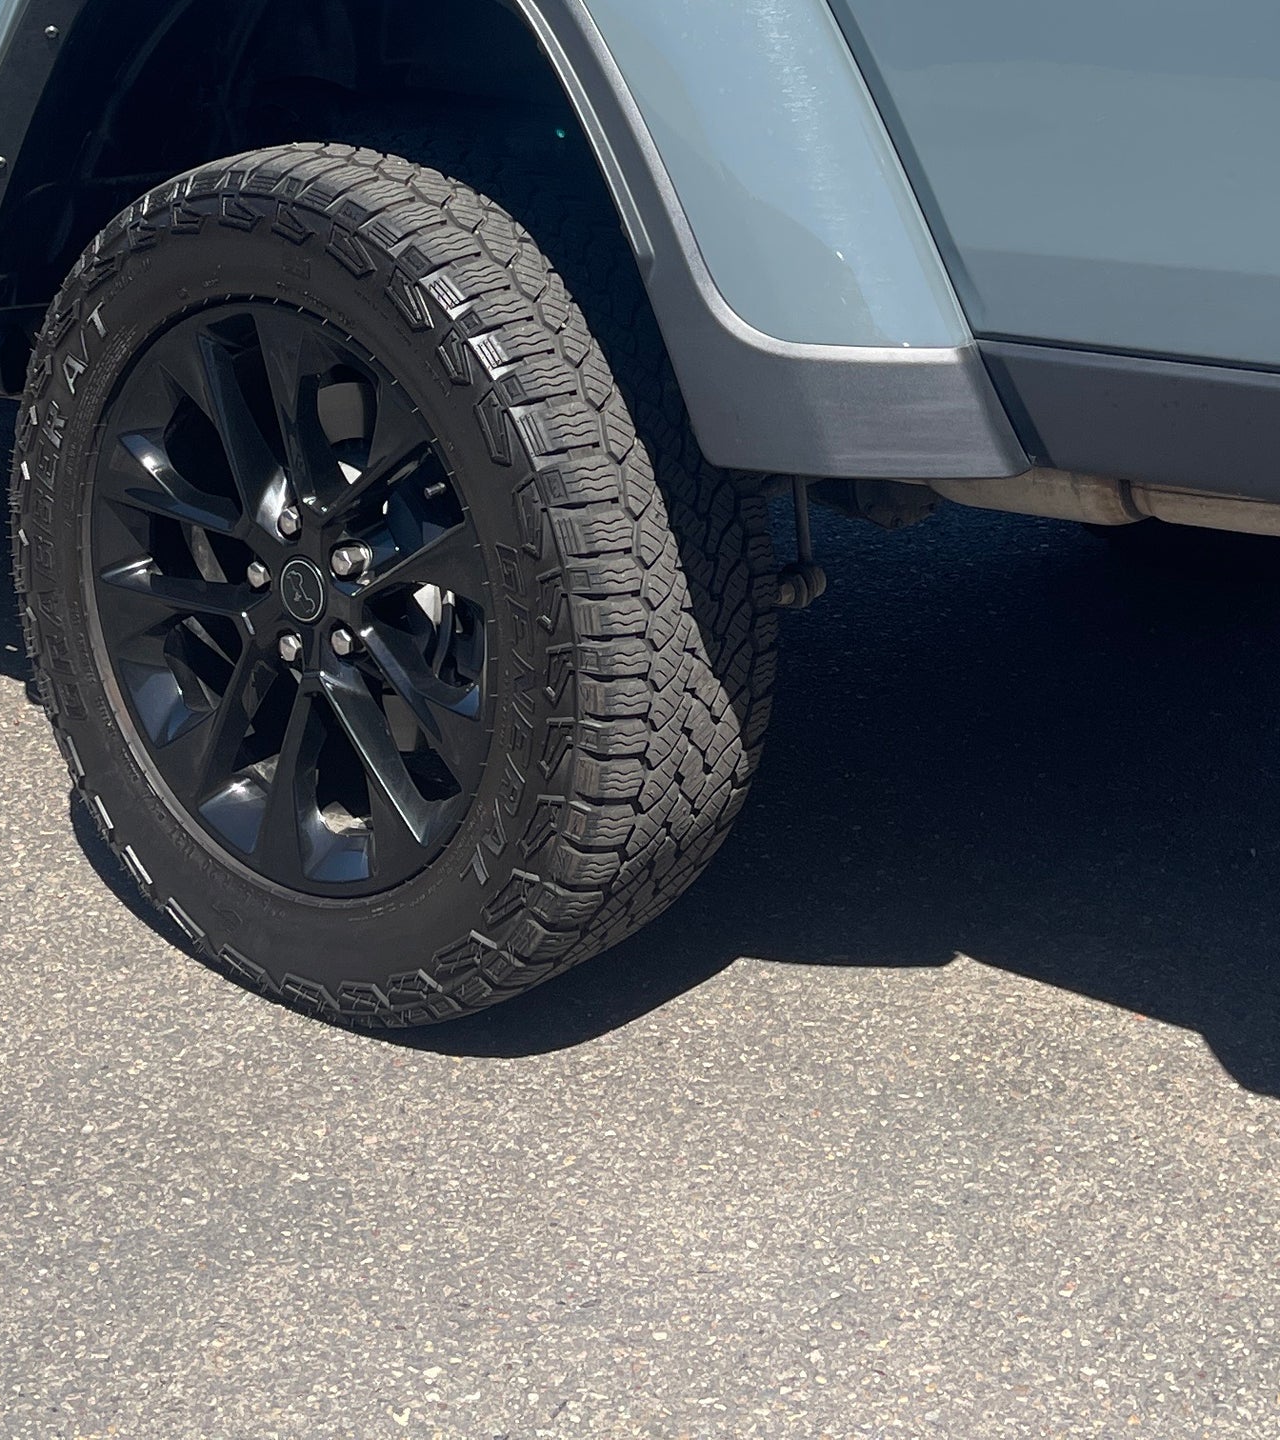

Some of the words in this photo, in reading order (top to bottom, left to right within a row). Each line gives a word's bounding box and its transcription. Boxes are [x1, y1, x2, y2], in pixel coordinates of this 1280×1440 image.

[31, 397, 88, 721] GRABBER
[62, 299, 109, 396] A/T
[458, 541, 537, 887] GENERAL
